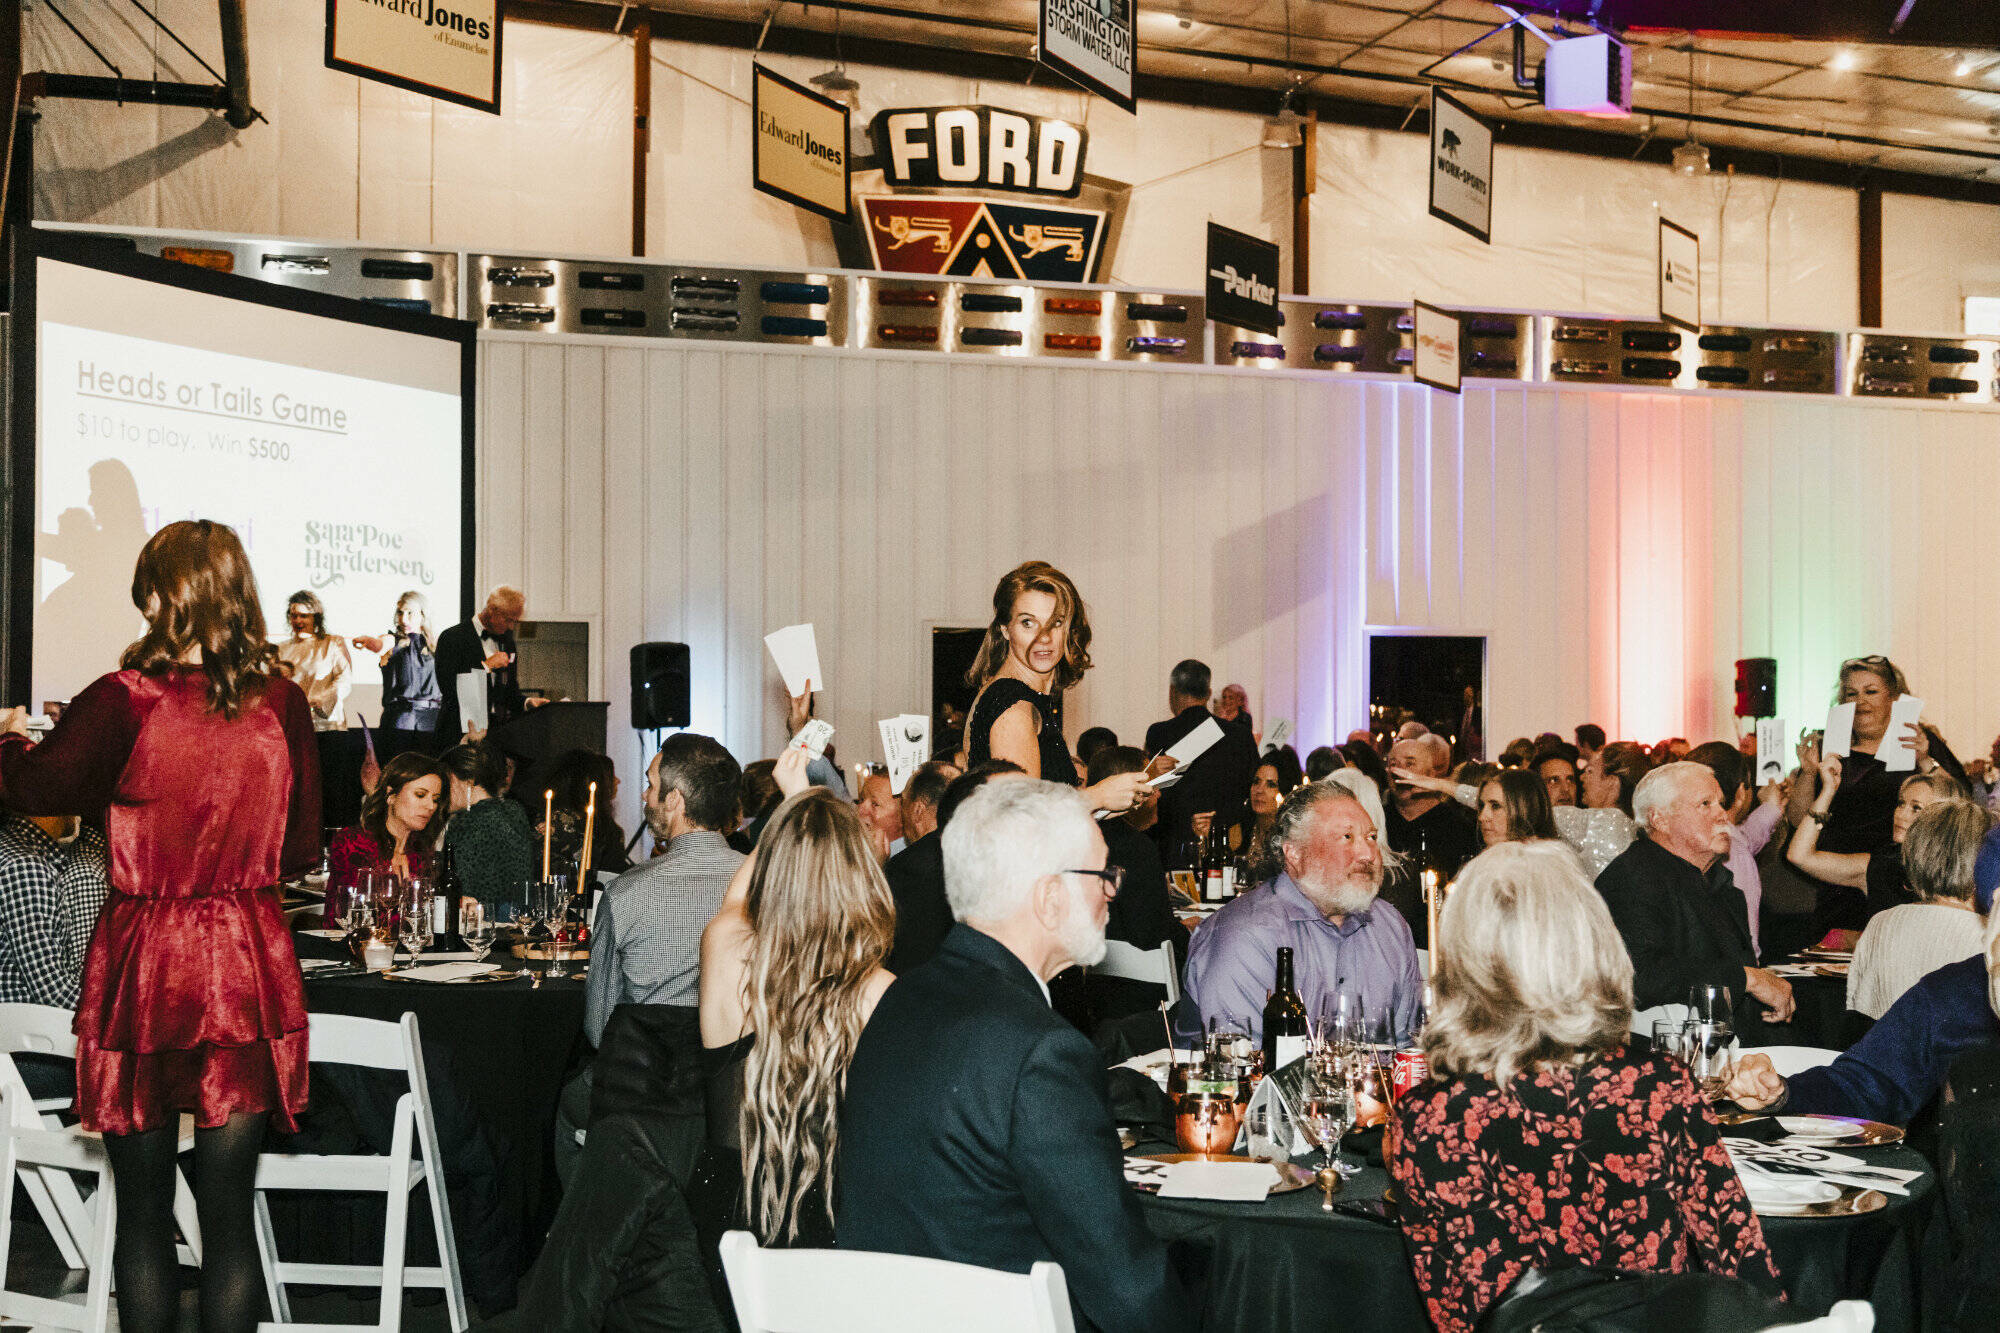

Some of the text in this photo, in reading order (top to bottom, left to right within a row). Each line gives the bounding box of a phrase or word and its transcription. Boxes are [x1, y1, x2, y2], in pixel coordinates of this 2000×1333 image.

[425, 0, 490, 40] Jones
[1048, 8, 1081, 45] STORM
[1115, 49, 1130, 75] LLC
[760, 111, 842, 165] Edward Jones
[887, 108, 1081, 191] FORD
[1209, 264, 1276, 306] Parker
[78, 360, 347, 429] Heads or Tails Game
[77, 412, 113, 438] $10
[121, 420, 141, 442] to
[208, 431, 242, 454] Win
[305, 519, 403, 549] Sara Poe
[304, 546, 435, 589] Hardersen
